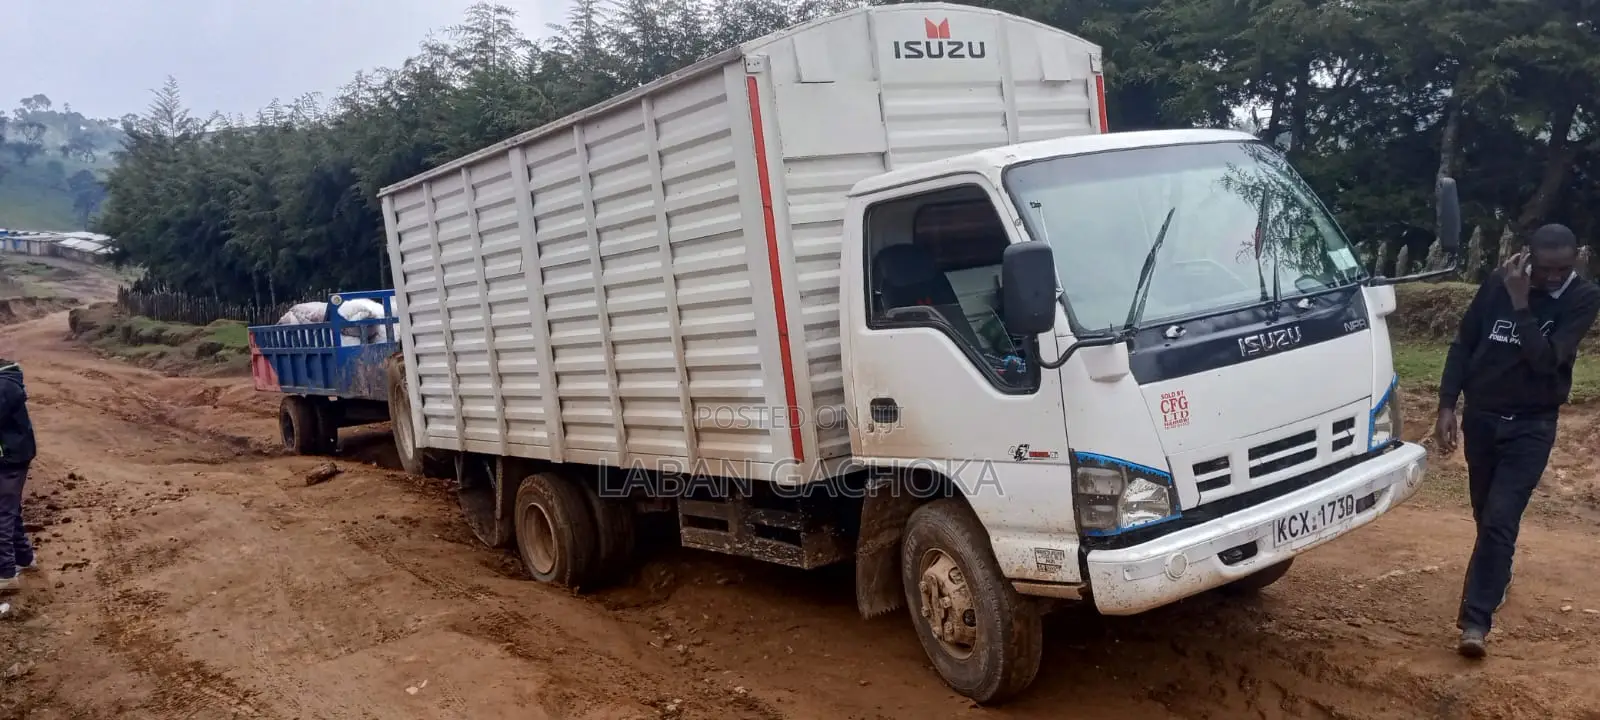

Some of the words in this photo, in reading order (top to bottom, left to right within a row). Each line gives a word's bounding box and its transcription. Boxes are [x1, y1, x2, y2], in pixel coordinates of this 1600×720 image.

[893, 40, 986, 59] ISUZU
[1238, 326, 1302, 357] ISUZU
[1160, 396, 1189, 414] CFG
[1163, 411, 1189, 422] LTD
[1277, 510, 1310, 543] KCX
[1318, 494, 1354, 527] 173D
